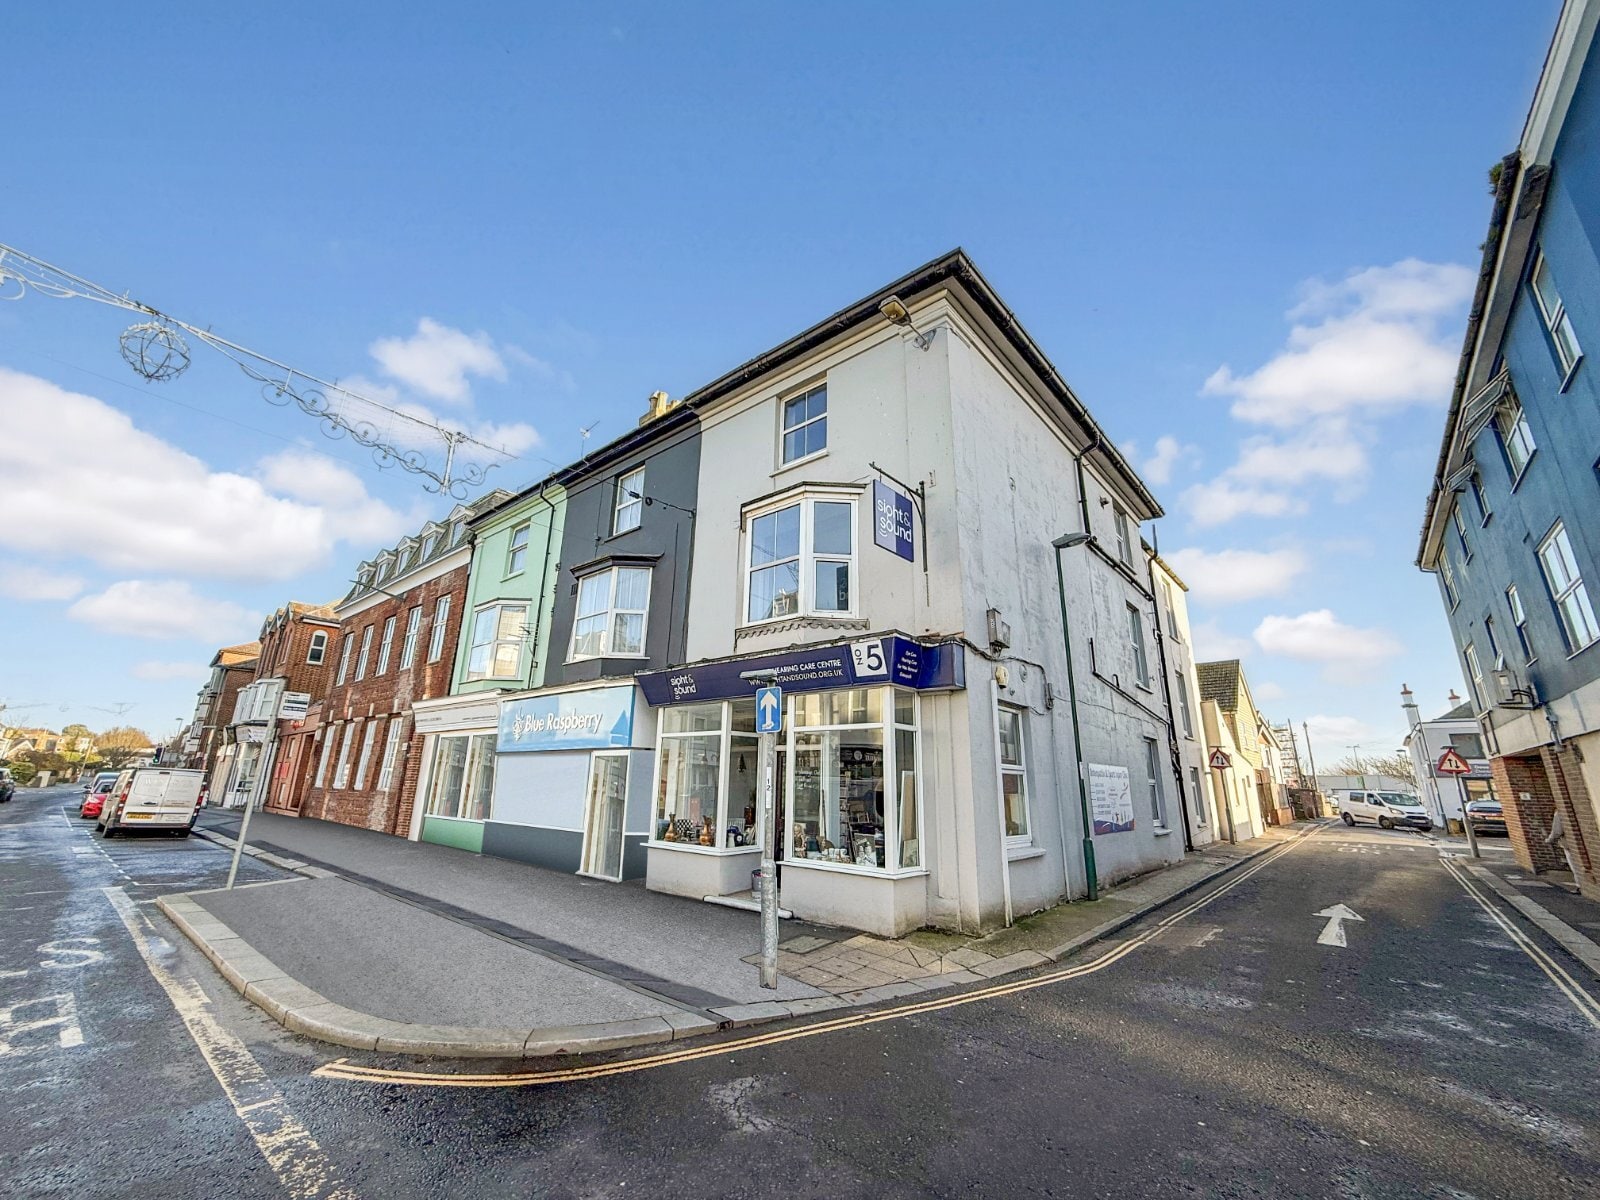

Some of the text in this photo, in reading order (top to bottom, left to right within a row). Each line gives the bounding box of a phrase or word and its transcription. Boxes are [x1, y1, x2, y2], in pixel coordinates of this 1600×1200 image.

[880, 516, 912, 543] sound
[799, 662, 816, 671] CARE
[816, 659, 842, 669] CENTRE
[866, 644, 883, 671] 5
[673, 683, 697, 695] sound
[524, 708, 604, 735] Blue Raspberry
